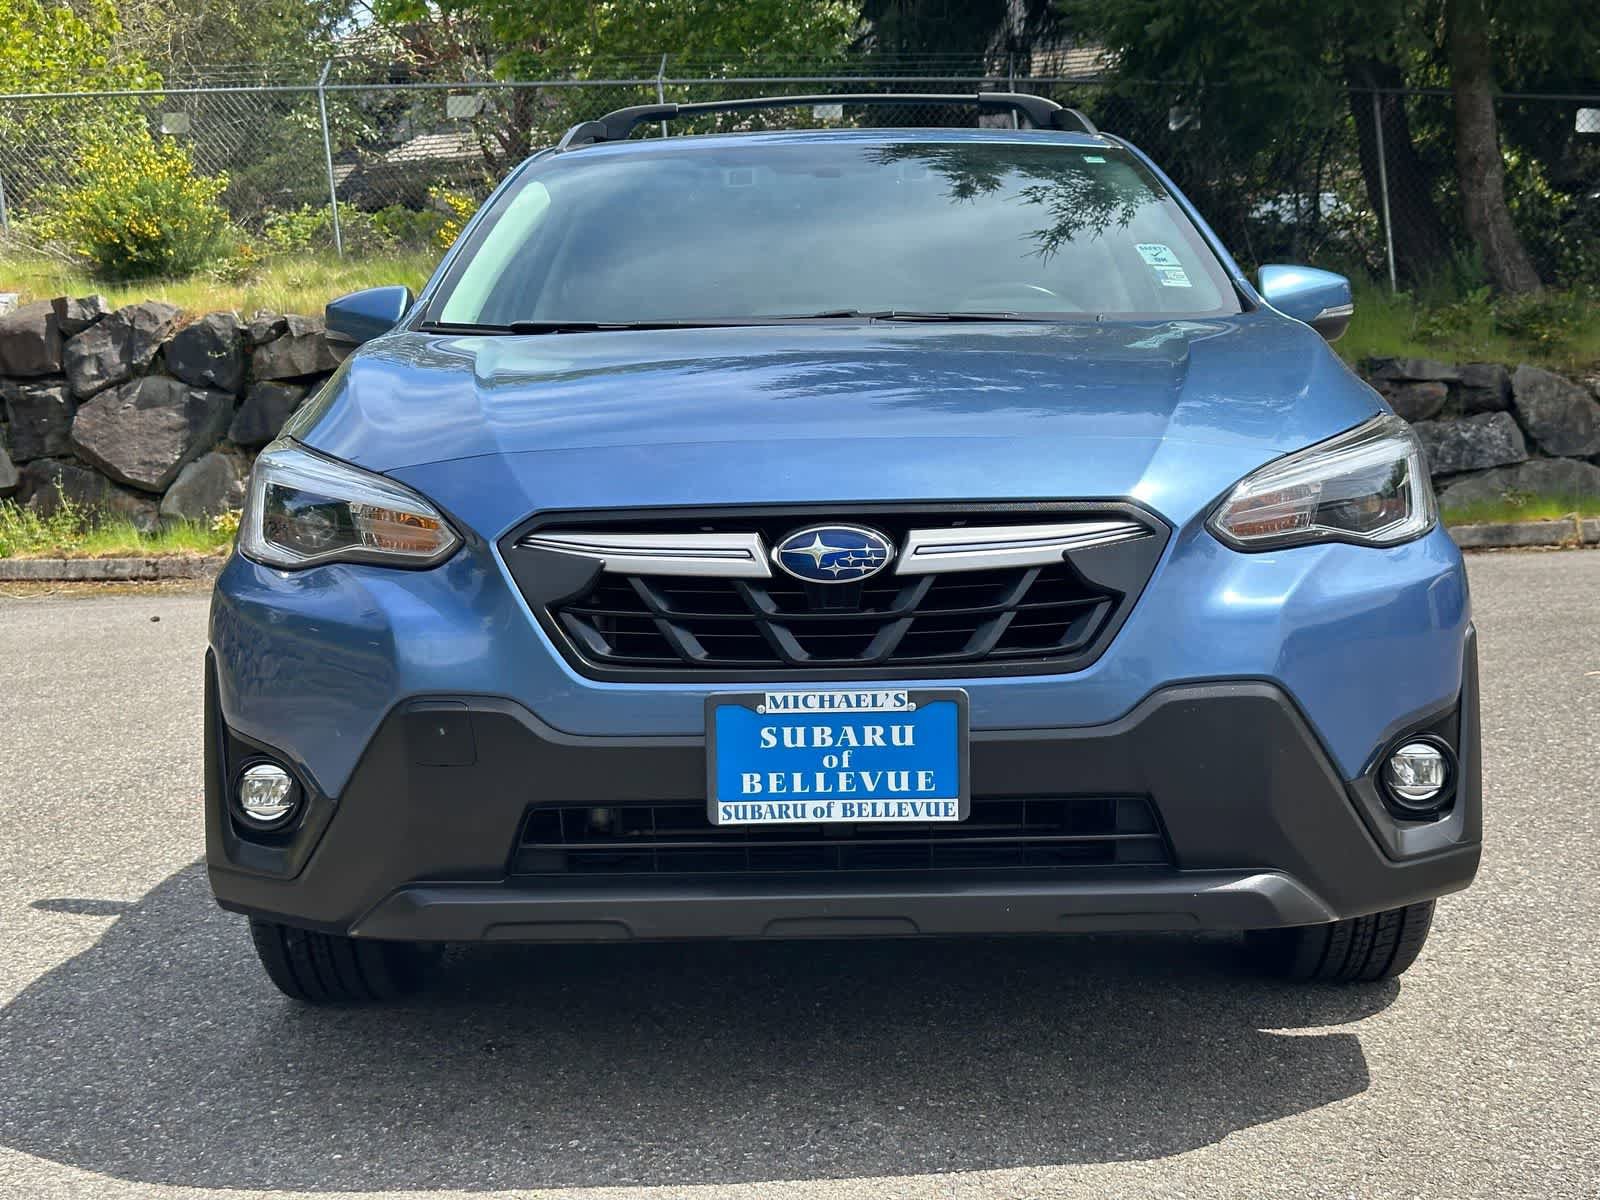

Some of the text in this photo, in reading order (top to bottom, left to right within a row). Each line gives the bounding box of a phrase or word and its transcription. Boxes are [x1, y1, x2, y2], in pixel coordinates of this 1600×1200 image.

[768, 692, 906, 709] MICHAEL'S
[760, 724, 915, 748] SUBARU
[822, 750, 852, 769] of
[741, 770, 936, 794] BELLEVUE
[721, 800, 956, 821] SUBARU of BELLEVUE
